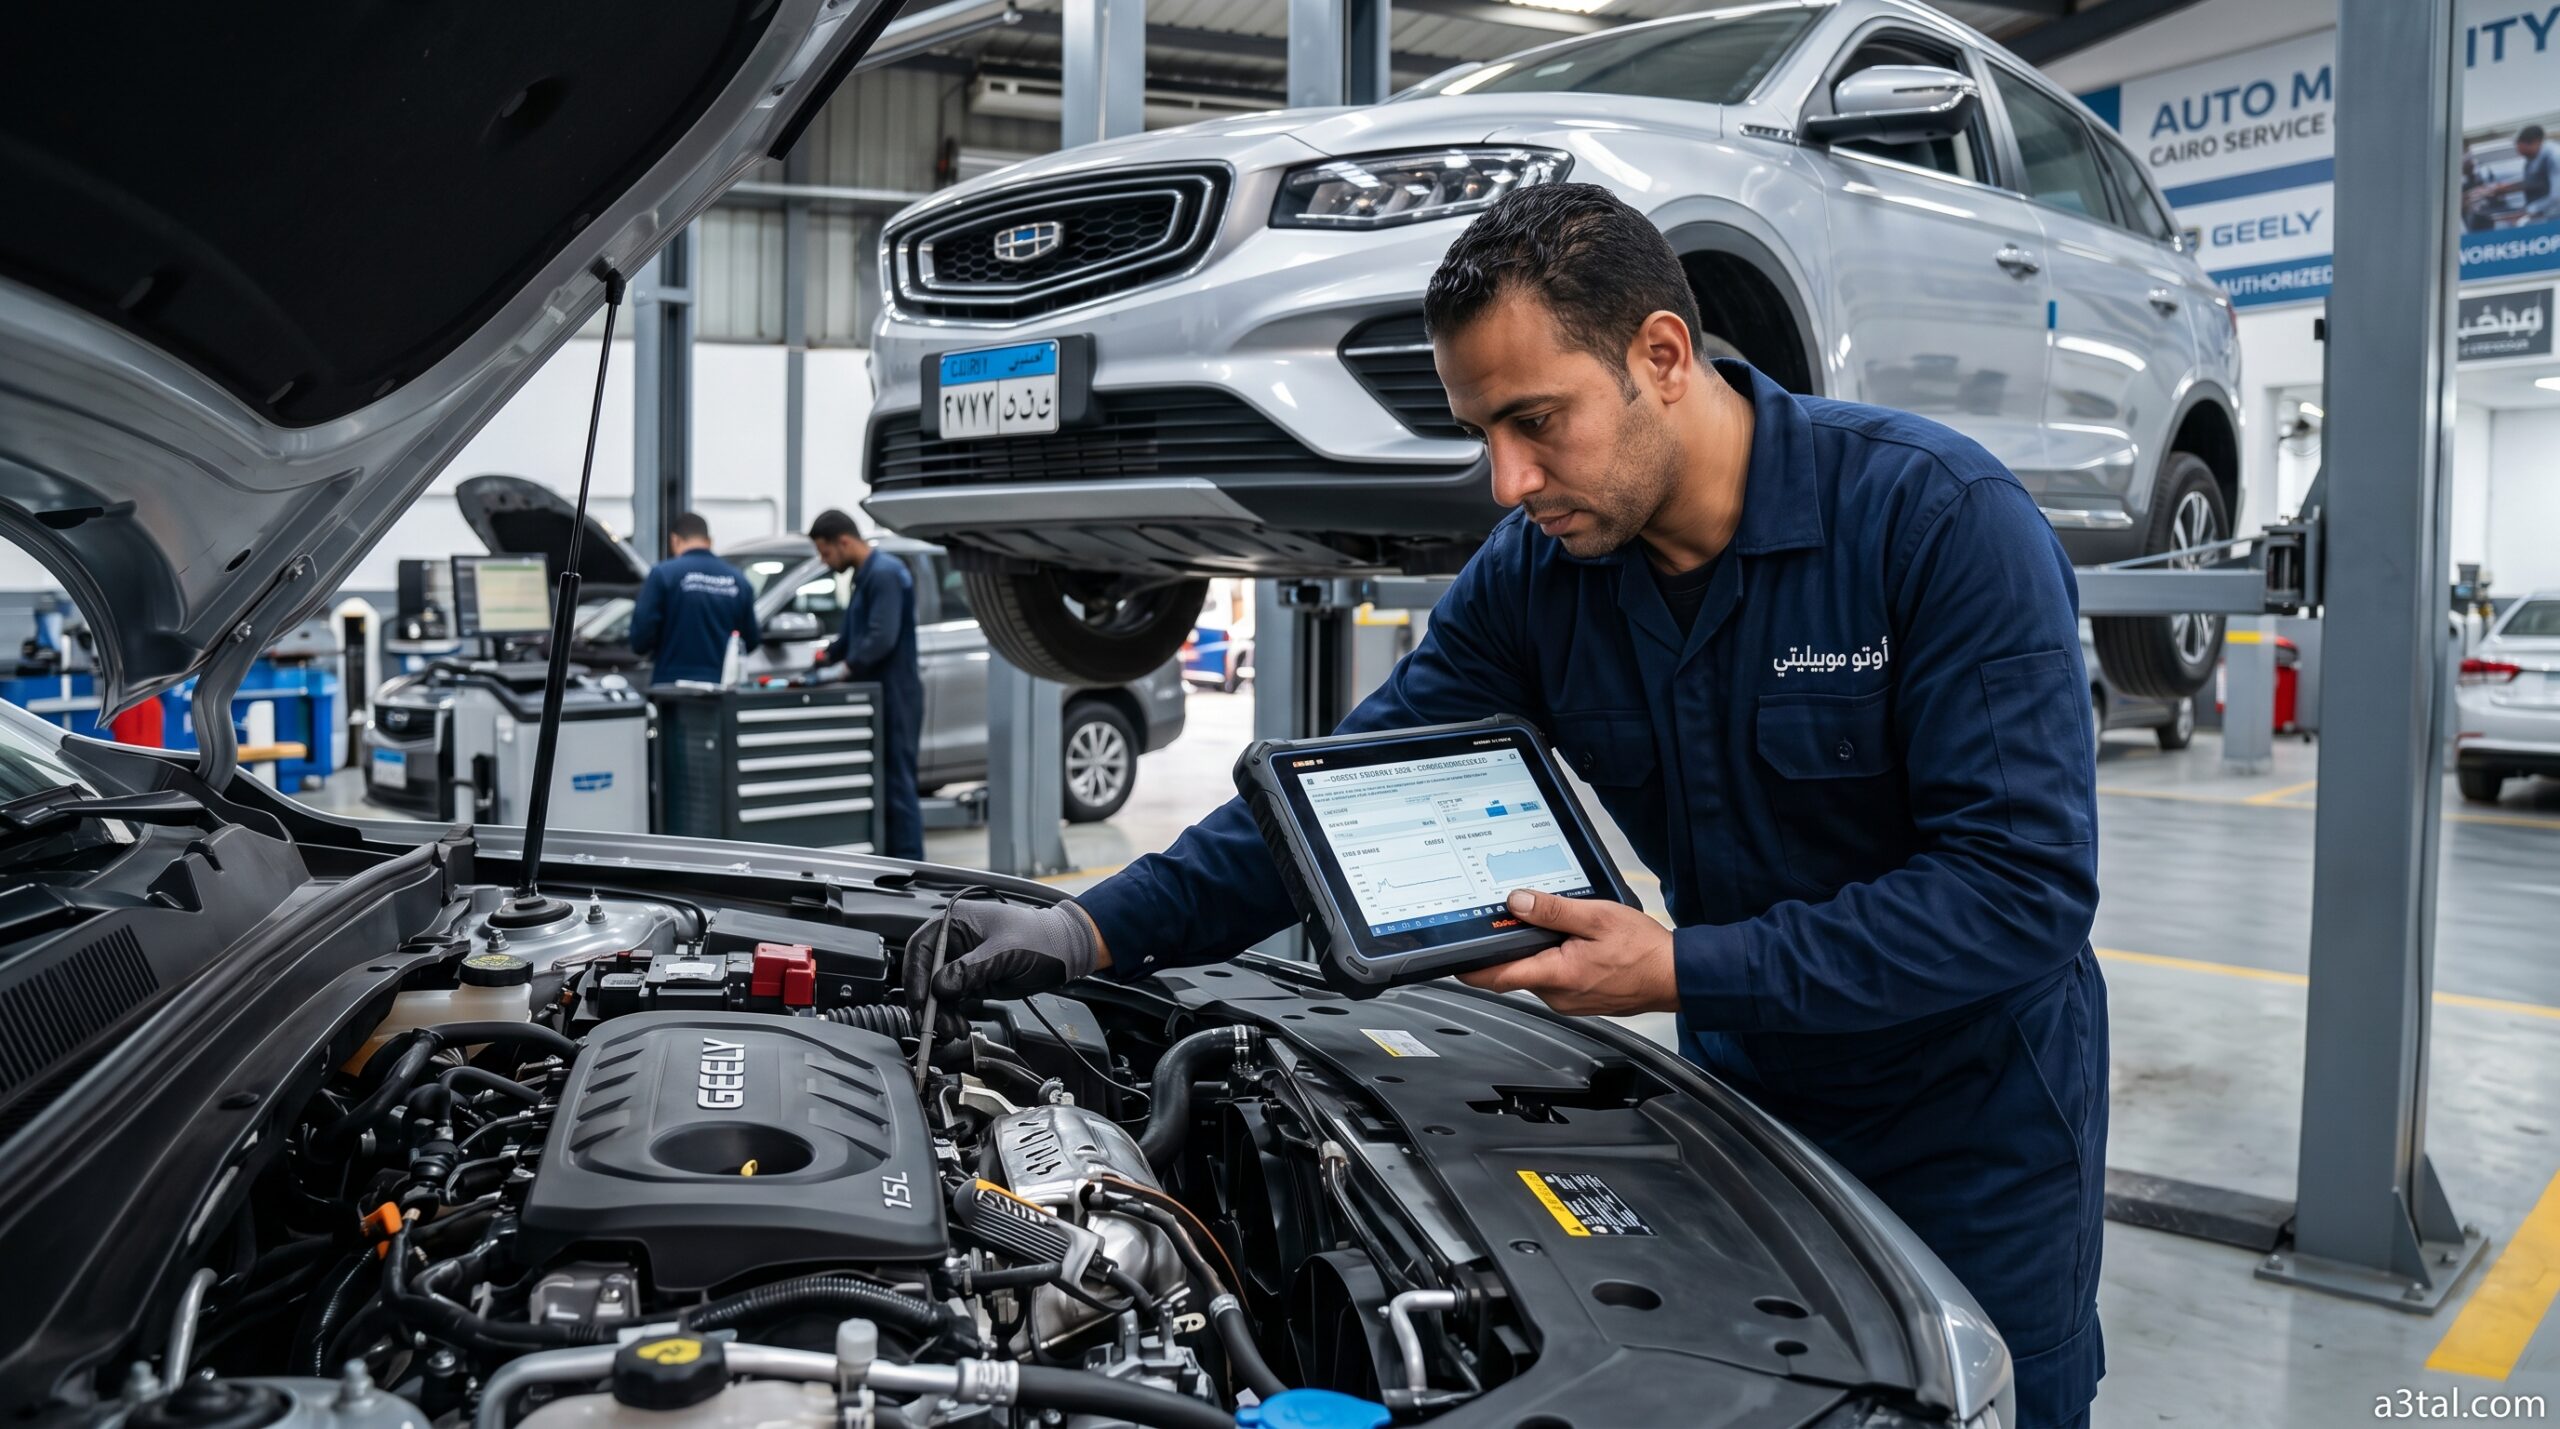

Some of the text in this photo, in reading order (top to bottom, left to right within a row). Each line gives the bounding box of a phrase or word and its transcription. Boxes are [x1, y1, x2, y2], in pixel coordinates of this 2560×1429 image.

[2150, 79, 2276, 139] AUTO
[2150, 113, 2326, 167] CAIRO SERVICE
[2213, 207, 2322, 248] GEELY
[1773, 635, 1889, 678] أوتو موبيليتي
[697, 1037, 745, 1109] GEELY
